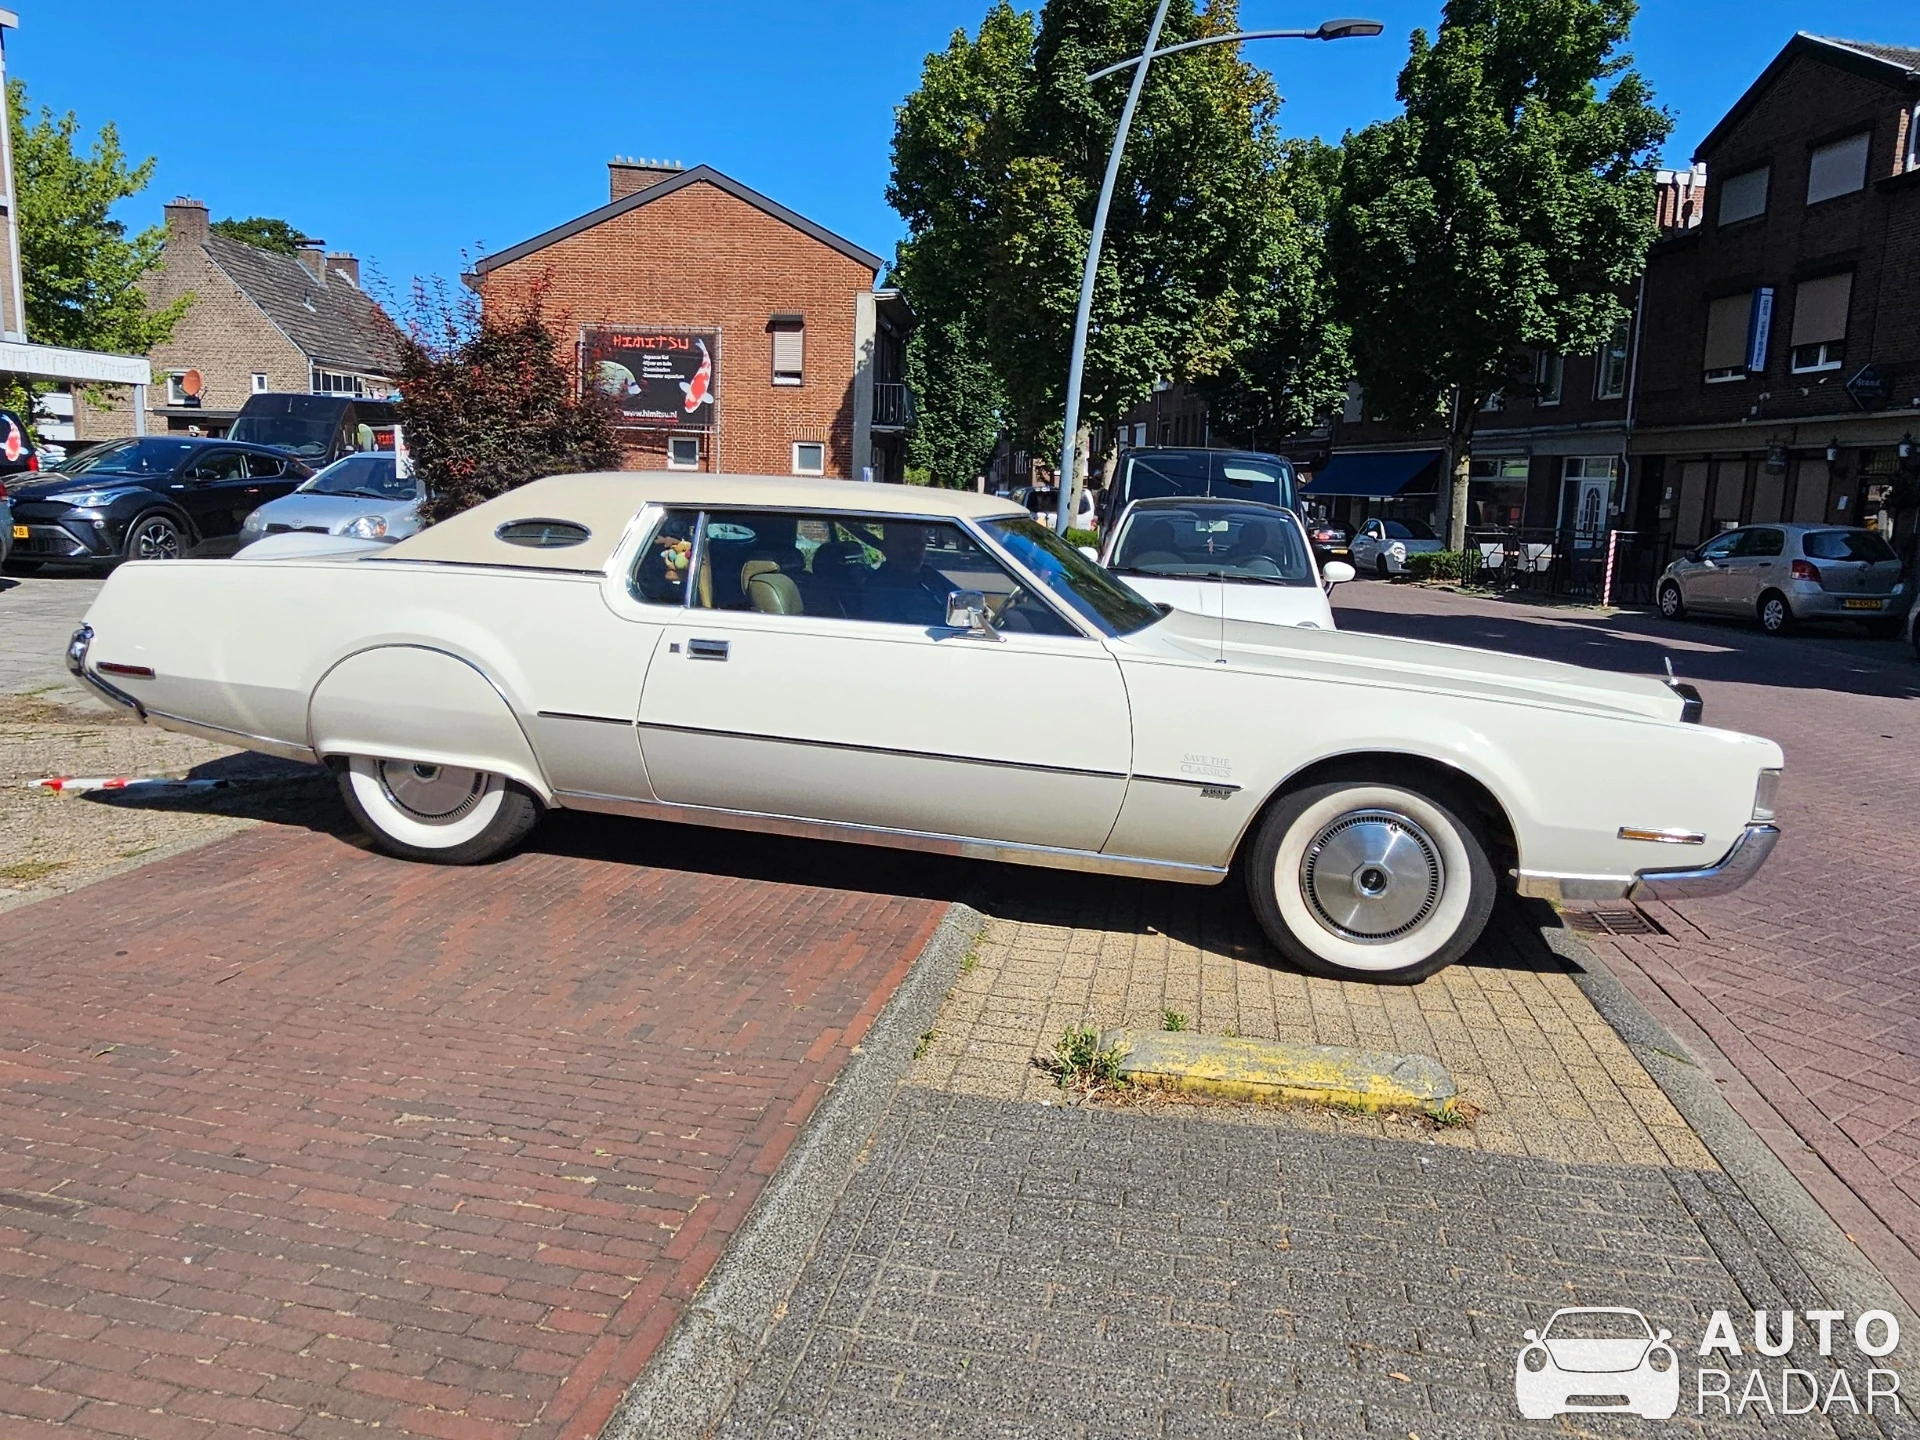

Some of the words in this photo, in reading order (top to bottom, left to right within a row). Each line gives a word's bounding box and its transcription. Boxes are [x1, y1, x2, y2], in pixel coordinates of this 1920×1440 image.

[613, 335, 689, 350] HIMITSU
[623, 410, 677, 418] www.himitsu.nl
[1183, 753, 1208, 764] SAVE
[1209, 757, 1230, 767] THE
[1181, 765, 1231, 778] CLASSICS
